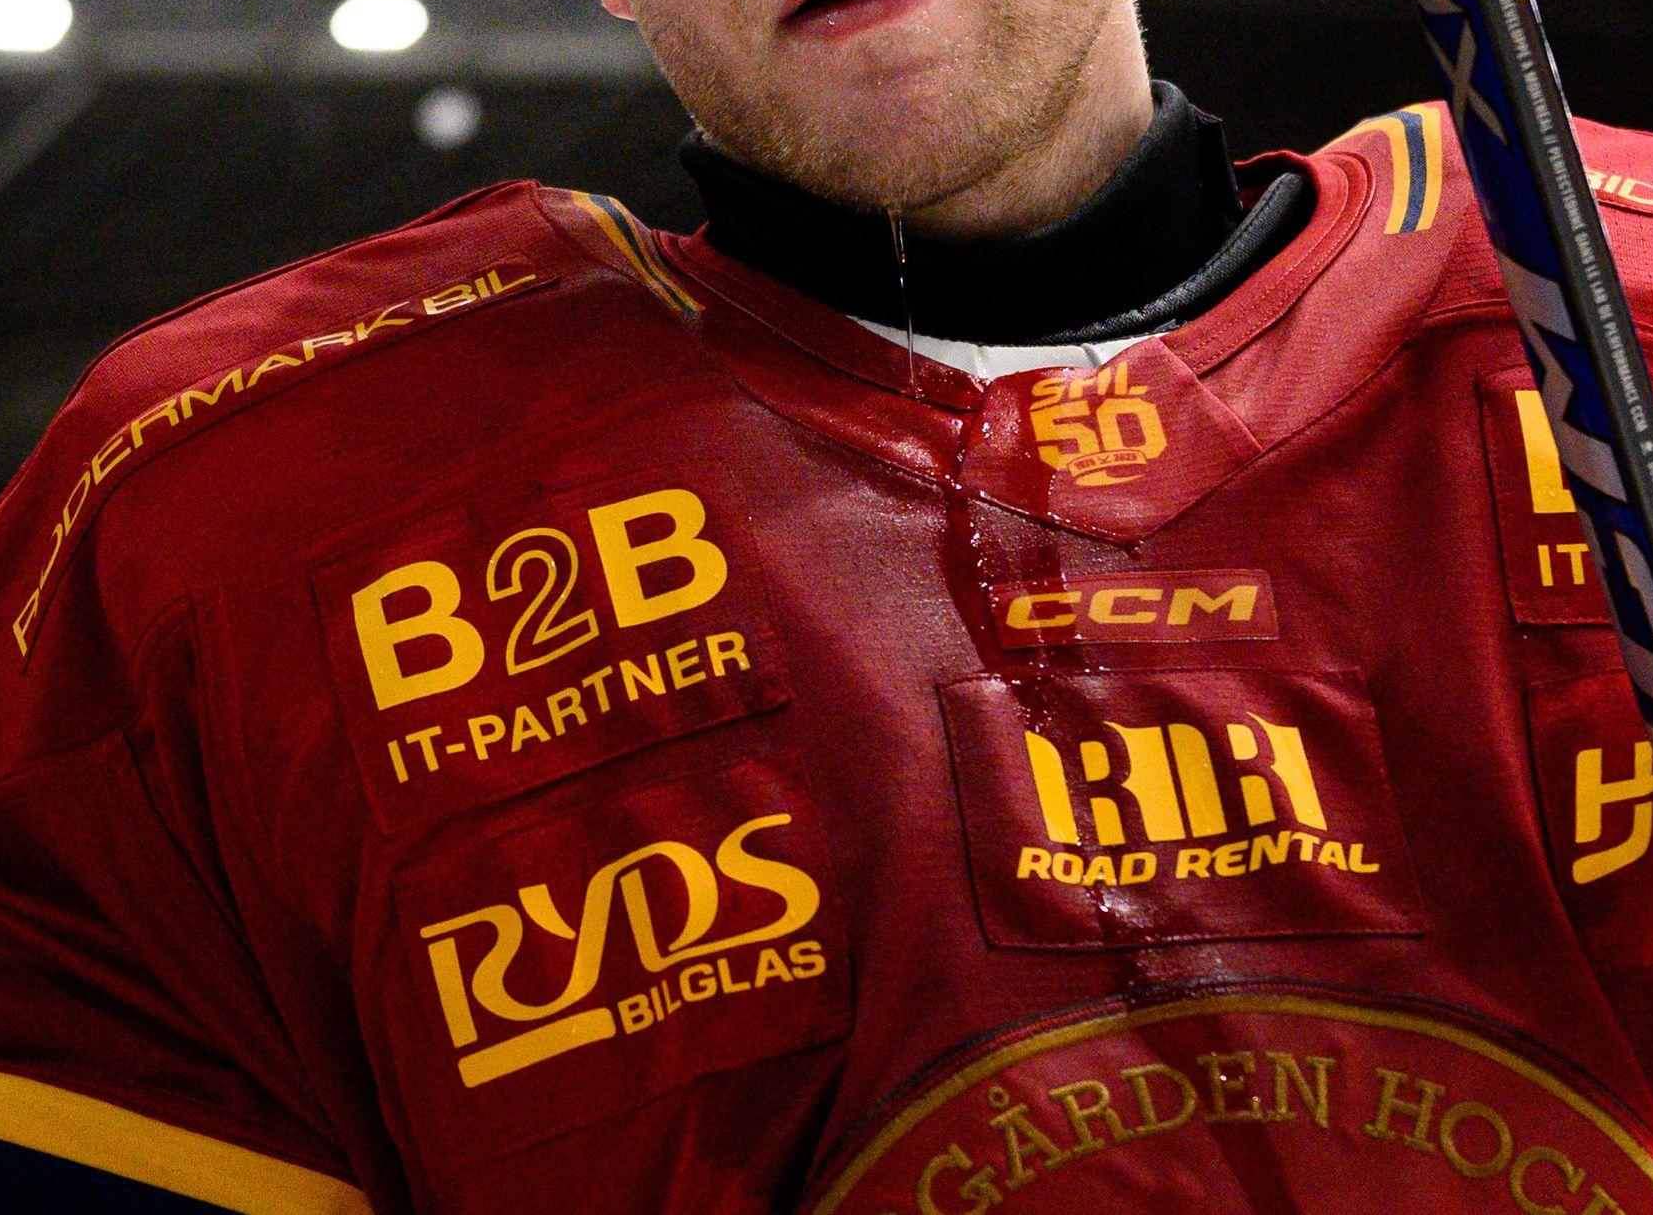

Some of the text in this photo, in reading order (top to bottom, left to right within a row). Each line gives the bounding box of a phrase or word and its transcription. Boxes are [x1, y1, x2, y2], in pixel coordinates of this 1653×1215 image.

[422, 270, 536, 316] BIL
[1030, 398, 1167, 474] 50
[352, 488, 728, 711] B2B
[1004, 584, 1259, 630] CCM
[387, 631, 751, 783] IT-PARTNER
[1016, 830, 1380, 886] ROAD RENTAL
[419, 812, 821, 1048] RYDS
[617, 940, 827, 1035] BILGLAS
[1363, 1067, 1628, 1215] HOC
